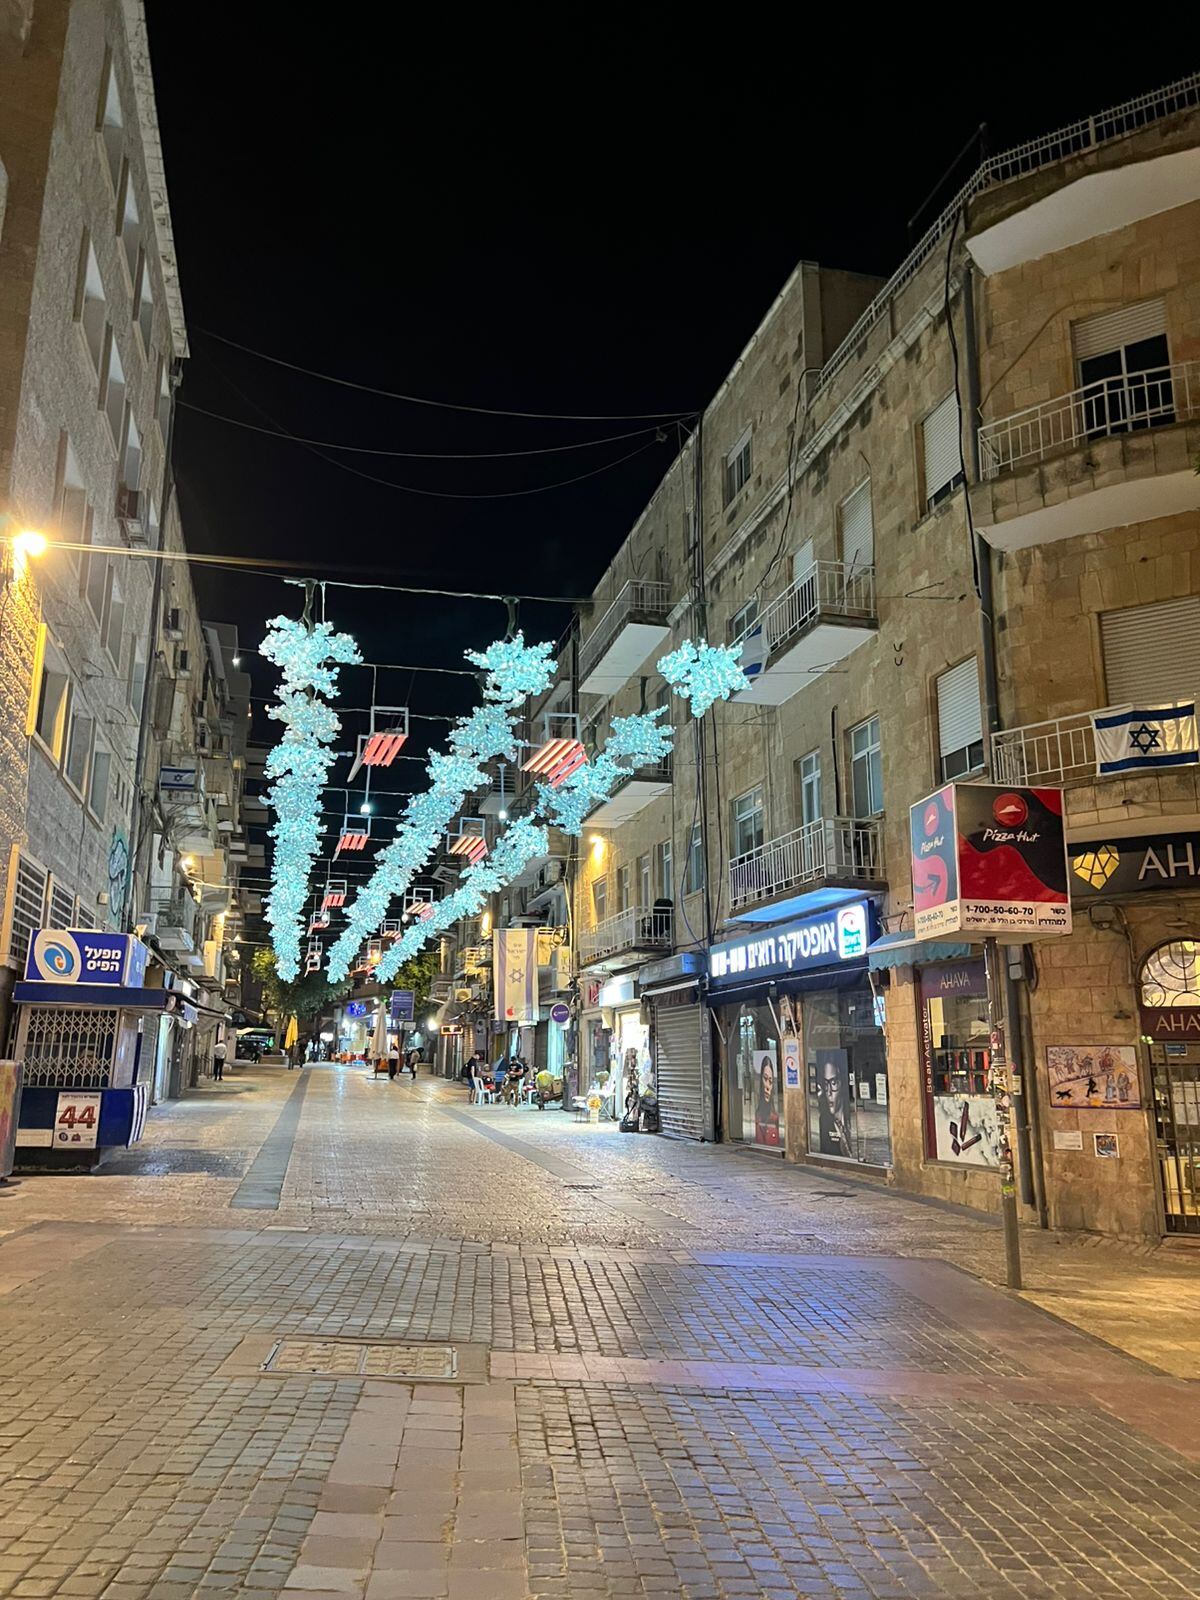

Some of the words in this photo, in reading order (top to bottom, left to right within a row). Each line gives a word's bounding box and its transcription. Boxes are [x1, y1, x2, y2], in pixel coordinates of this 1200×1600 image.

[983, 829, 1015, 841] Pizza
[1016, 831, 1040, 842] Hut
[1138, 842, 1200, 880] AH
[966, 905, 1034, 915] 1-700-50-60-70
[1038, 918, 1067, 926] למהדרין
[84, 946, 122, 960] מפעל
[748, 938, 776, 969] רואים
[778, 922, 837, 969] אופטיקה
[87, 961, 119, 972] הפיס
[940, 971, 971, 990] AHAVA
[1156, 1014, 1200, 1031] AHA
[923, 1007, 931, 1057] Activator
[925, 1061, 932, 1076] an
[925, 1078, 933, 1093] Be
[59, 1105, 96, 1129] 44
